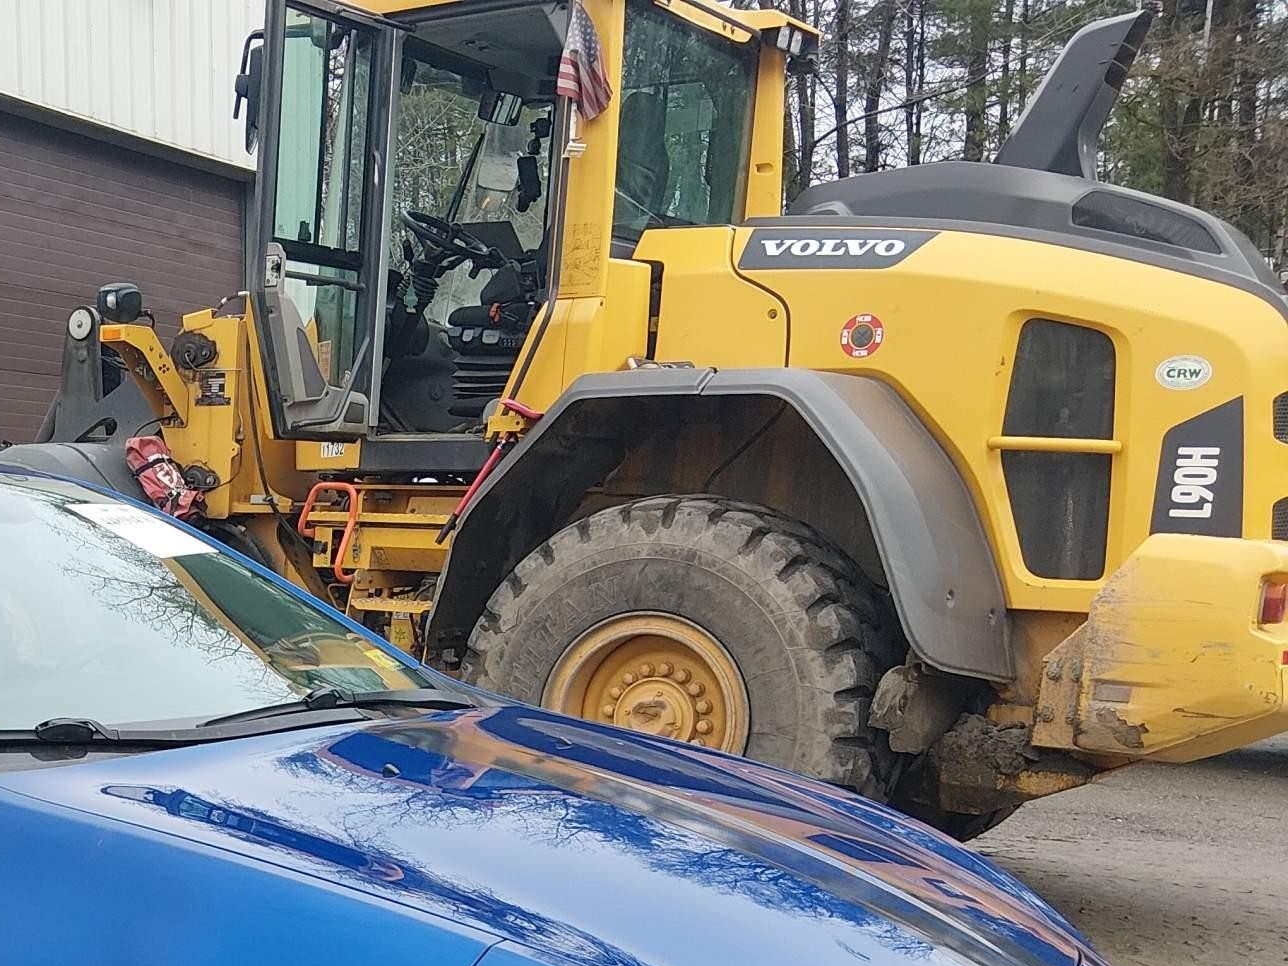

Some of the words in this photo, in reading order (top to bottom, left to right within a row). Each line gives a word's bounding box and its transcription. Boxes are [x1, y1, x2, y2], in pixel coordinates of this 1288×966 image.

[761, 239, 905, 256] VOLVO
[1166, 368, 1202, 379] CRW
[1168, 447, 1220, 518] L90H
